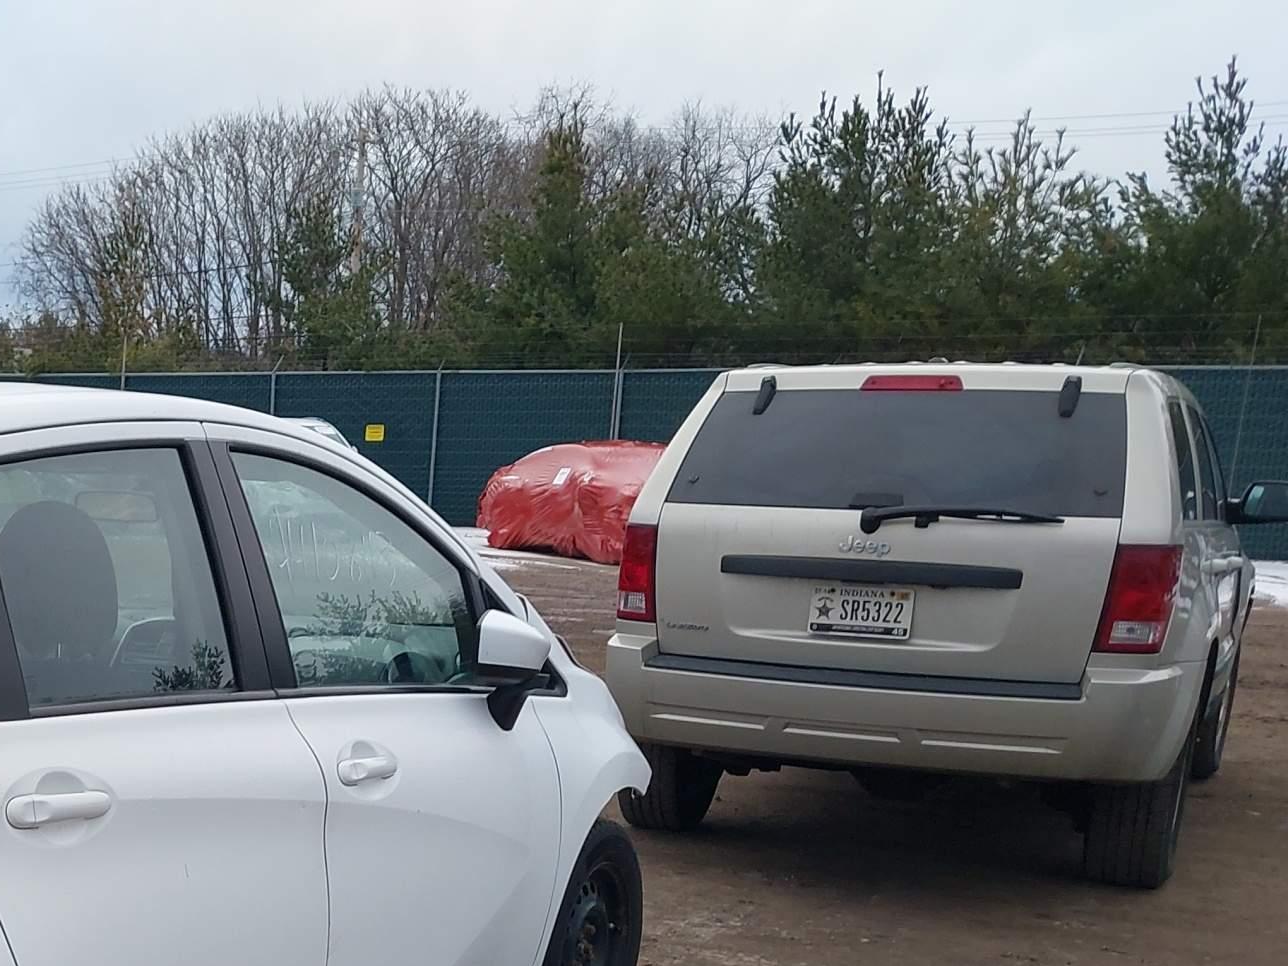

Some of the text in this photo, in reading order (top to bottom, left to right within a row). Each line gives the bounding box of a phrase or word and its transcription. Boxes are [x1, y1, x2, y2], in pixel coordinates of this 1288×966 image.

[839, 535, 891, 556] Jeep
[840, 588, 885, 598] INDIANA
[839, 599, 904, 624] SR5322
